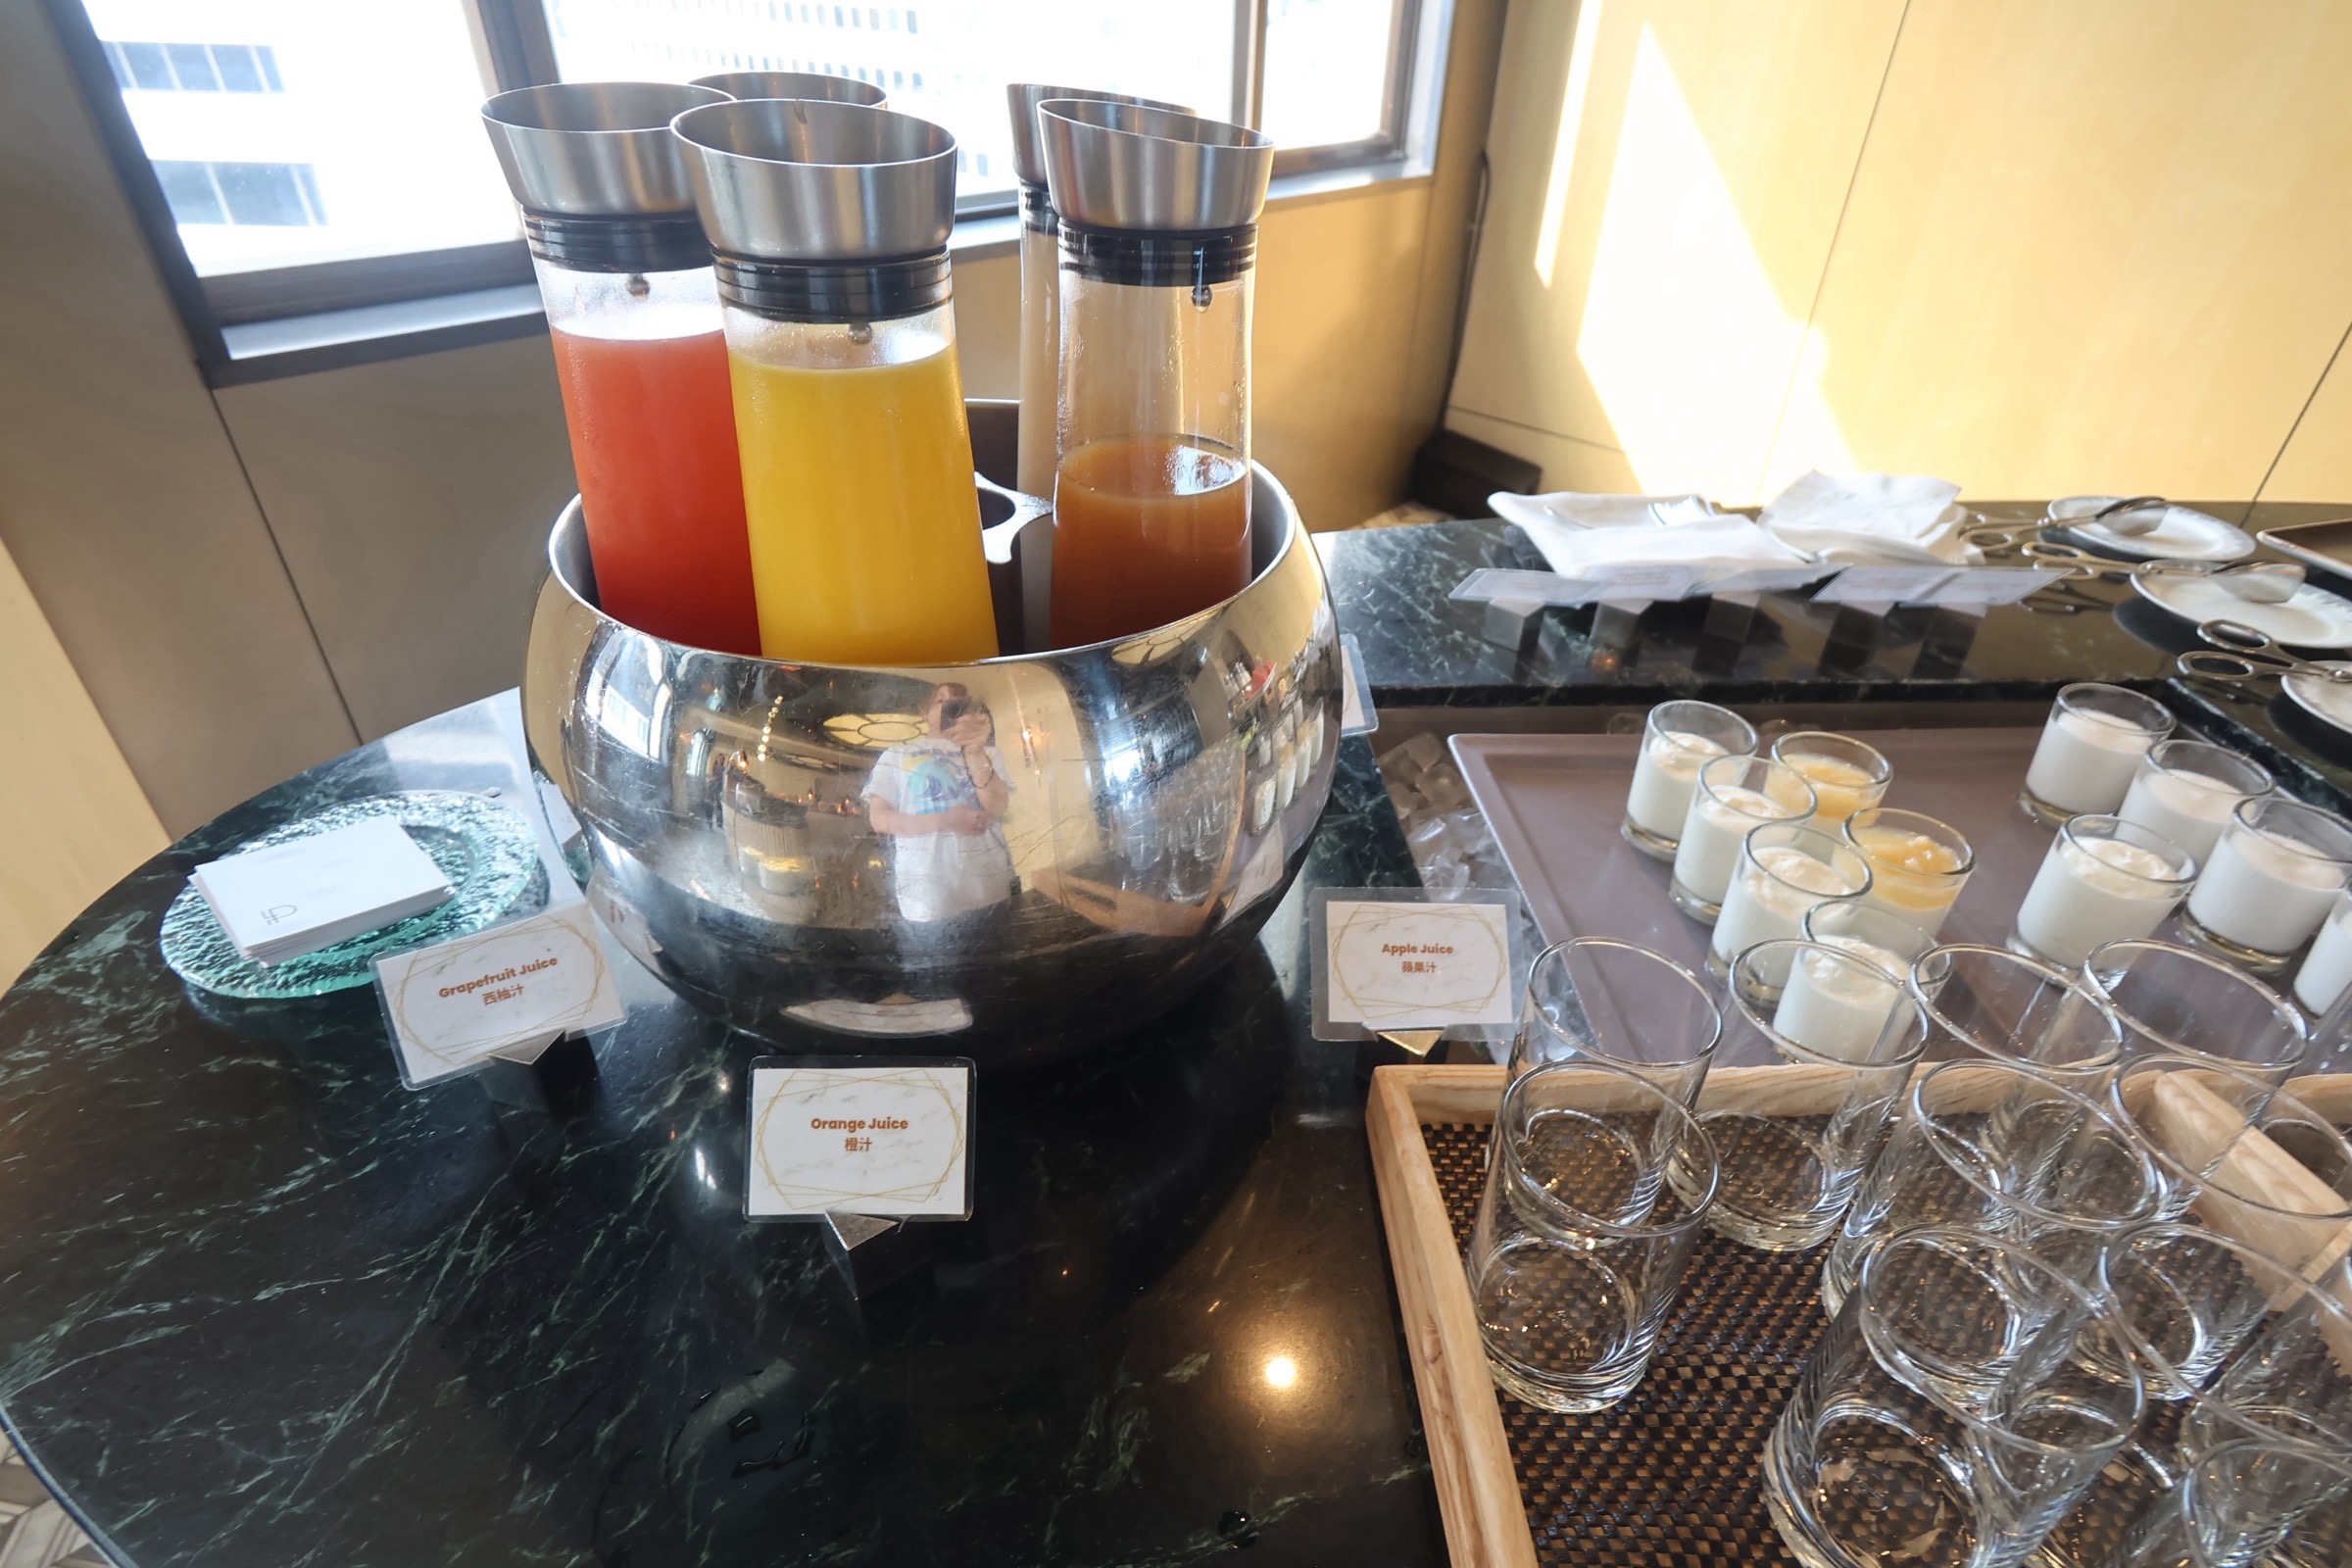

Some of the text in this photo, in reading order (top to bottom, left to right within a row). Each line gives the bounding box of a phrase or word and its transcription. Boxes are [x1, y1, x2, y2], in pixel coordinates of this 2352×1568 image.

[1382, 943, 1453, 956] Apple Juice
[438, 957, 559, 999] Grapefruit Juice
[481, 983, 524, 1005] 西柚汁
[810, 1116, 909, 1134] Orange Juice
[845, 1137, 873, 1152] 橙汁
